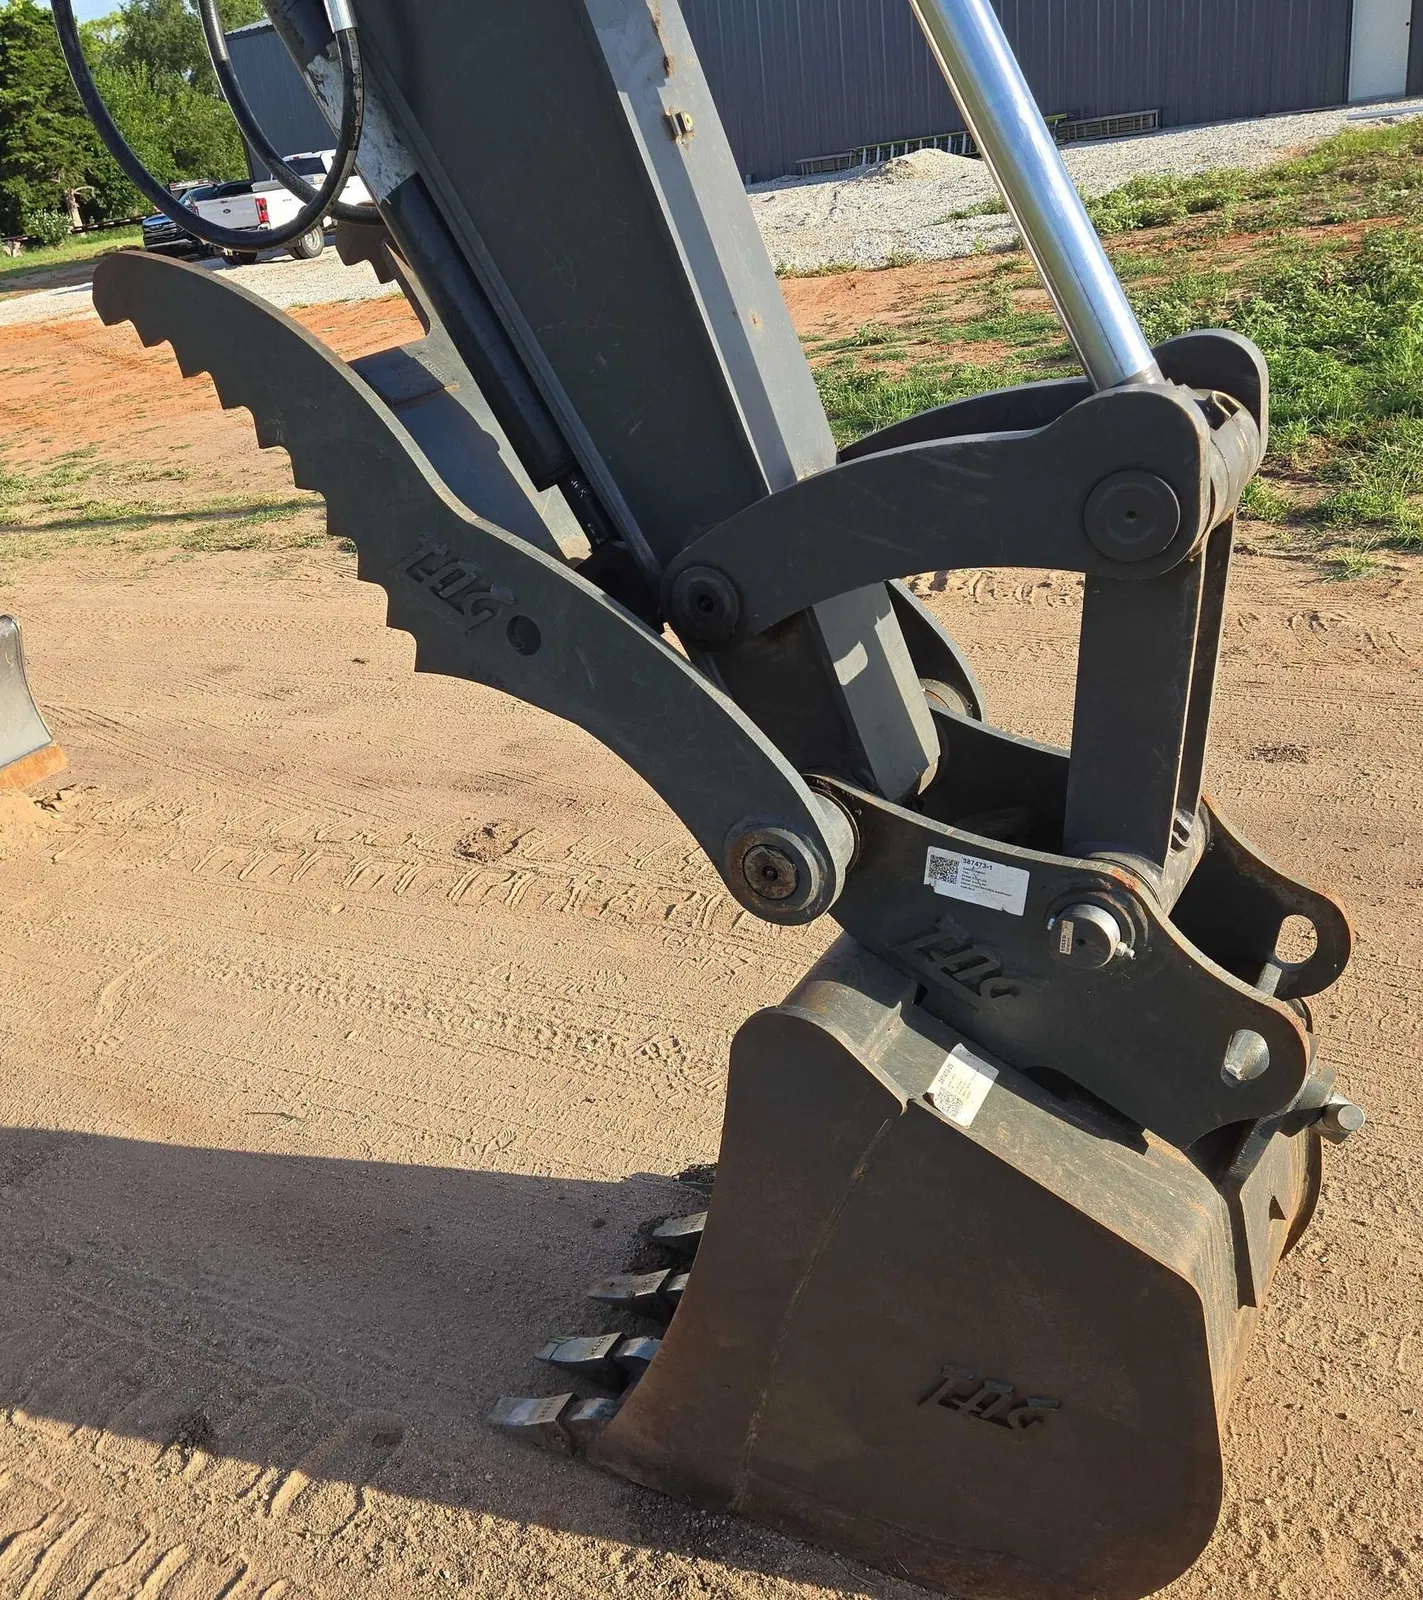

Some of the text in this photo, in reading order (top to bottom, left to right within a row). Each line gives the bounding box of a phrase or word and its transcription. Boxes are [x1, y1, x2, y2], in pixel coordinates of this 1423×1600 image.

[398, 532, 515, 634] TAG
[962, 858, 993, 870] 387473-1
[892, 914, 1036, 1011] TAG
[921, 1363, 1061, 1436] TAG
